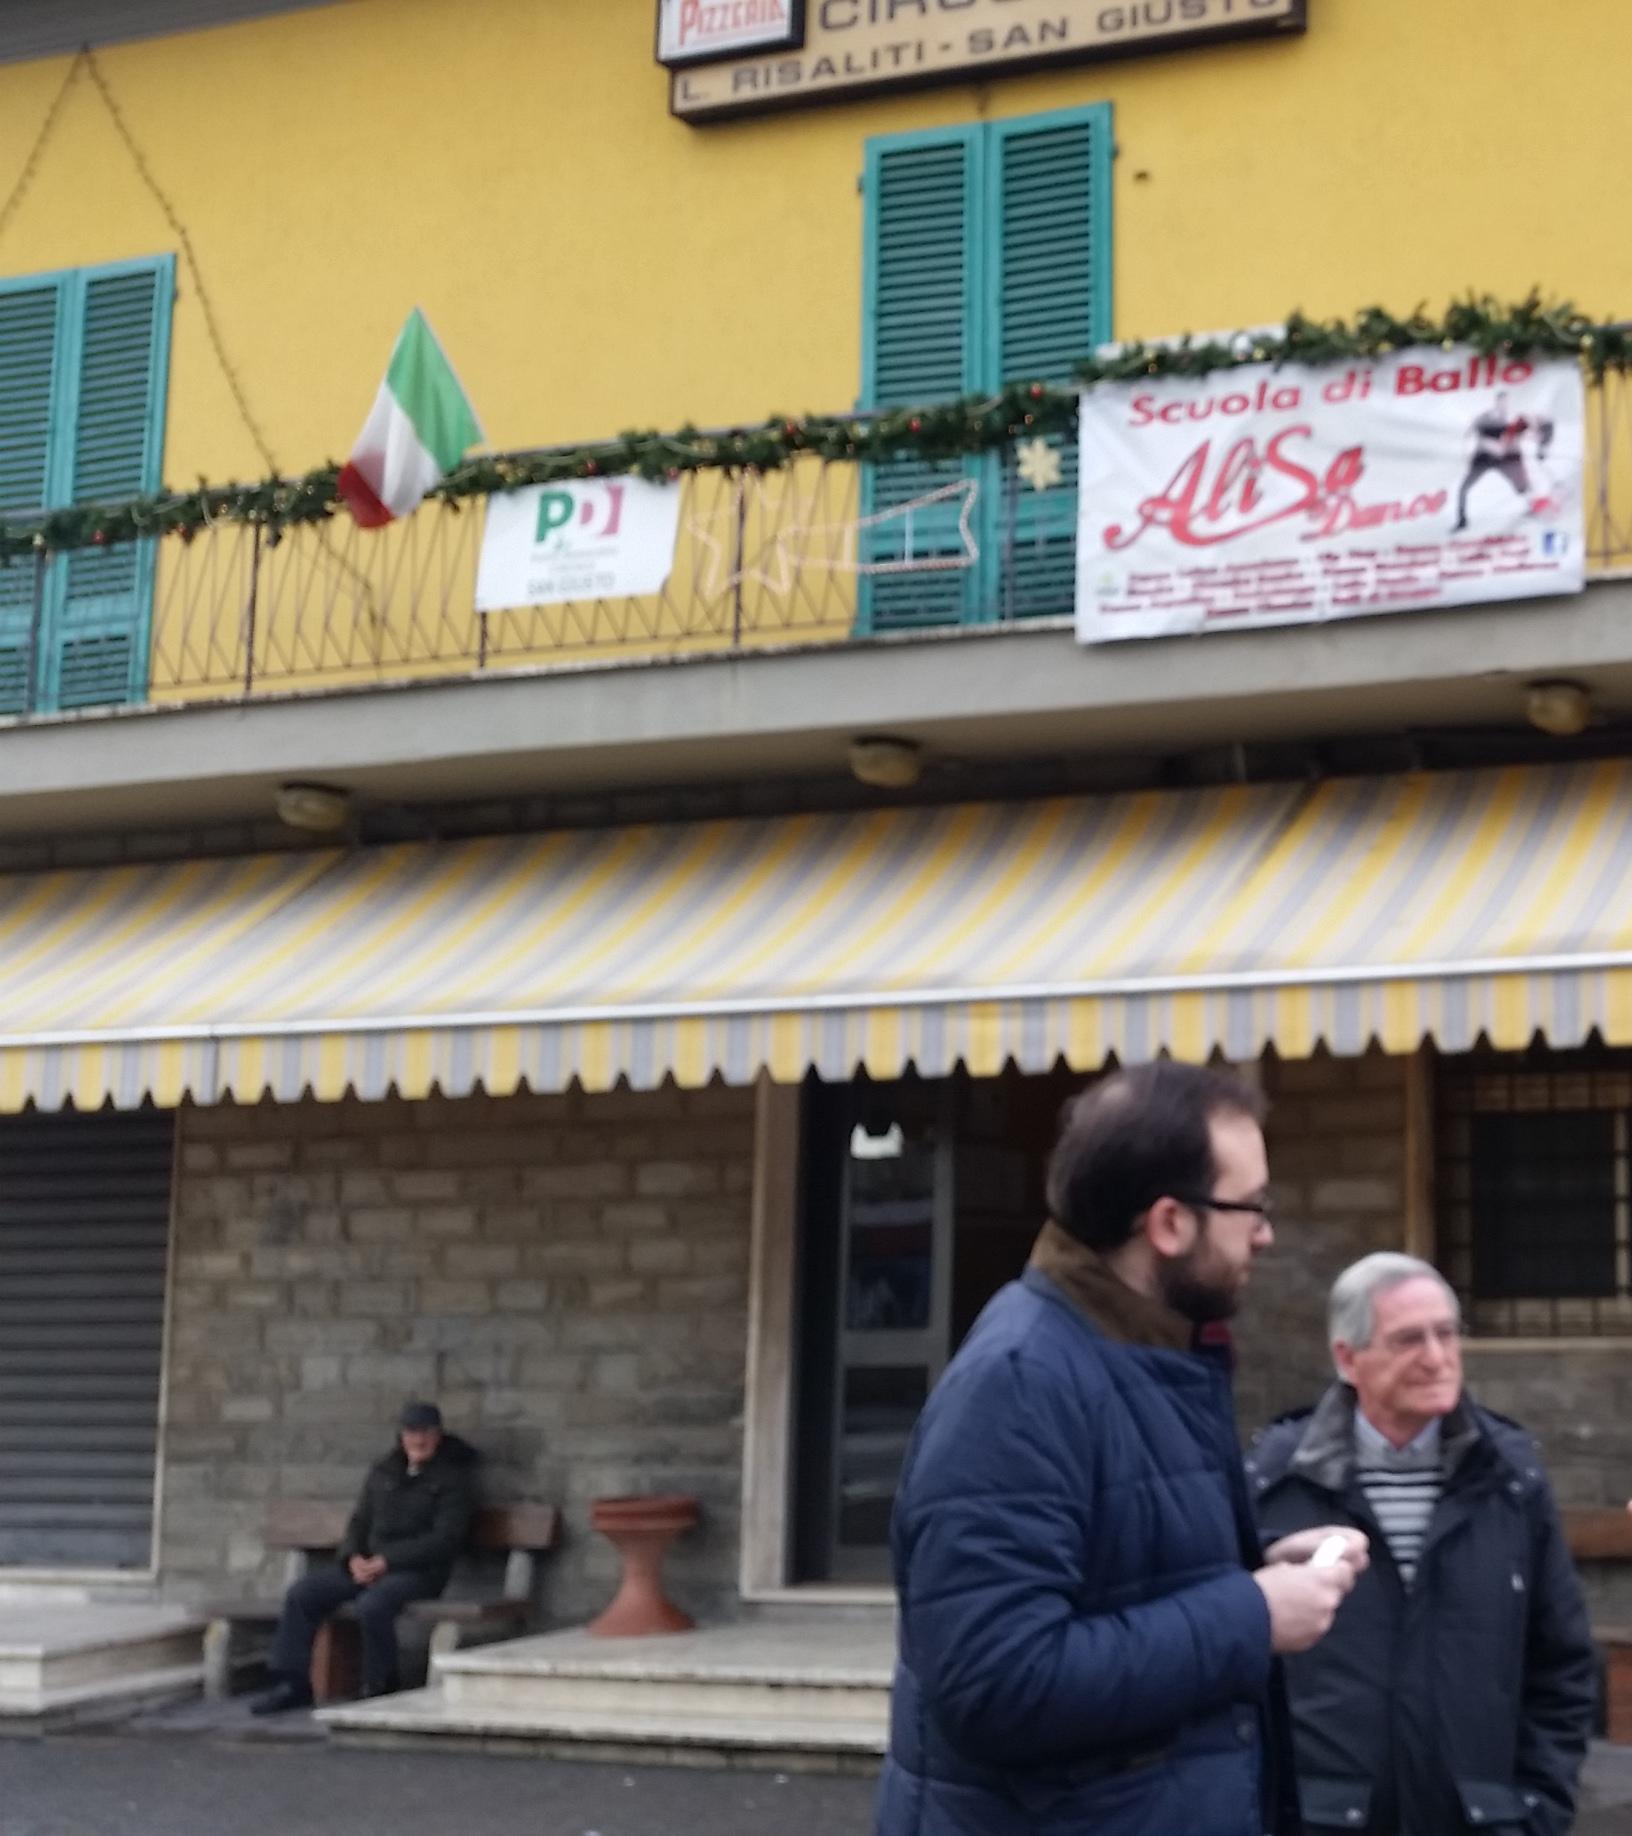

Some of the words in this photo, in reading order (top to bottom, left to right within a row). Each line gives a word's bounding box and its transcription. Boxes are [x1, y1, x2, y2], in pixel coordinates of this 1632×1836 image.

[732, 40, 924, 93] RISALITI
[967, 17, 1068, 54] SAN
[1129, 378, 1302, 427] Scuola
[1322, 366, 1374, 404] di
[1395, 352, 1533, 396] Ballo
[535, 485, 625, 544] PD
